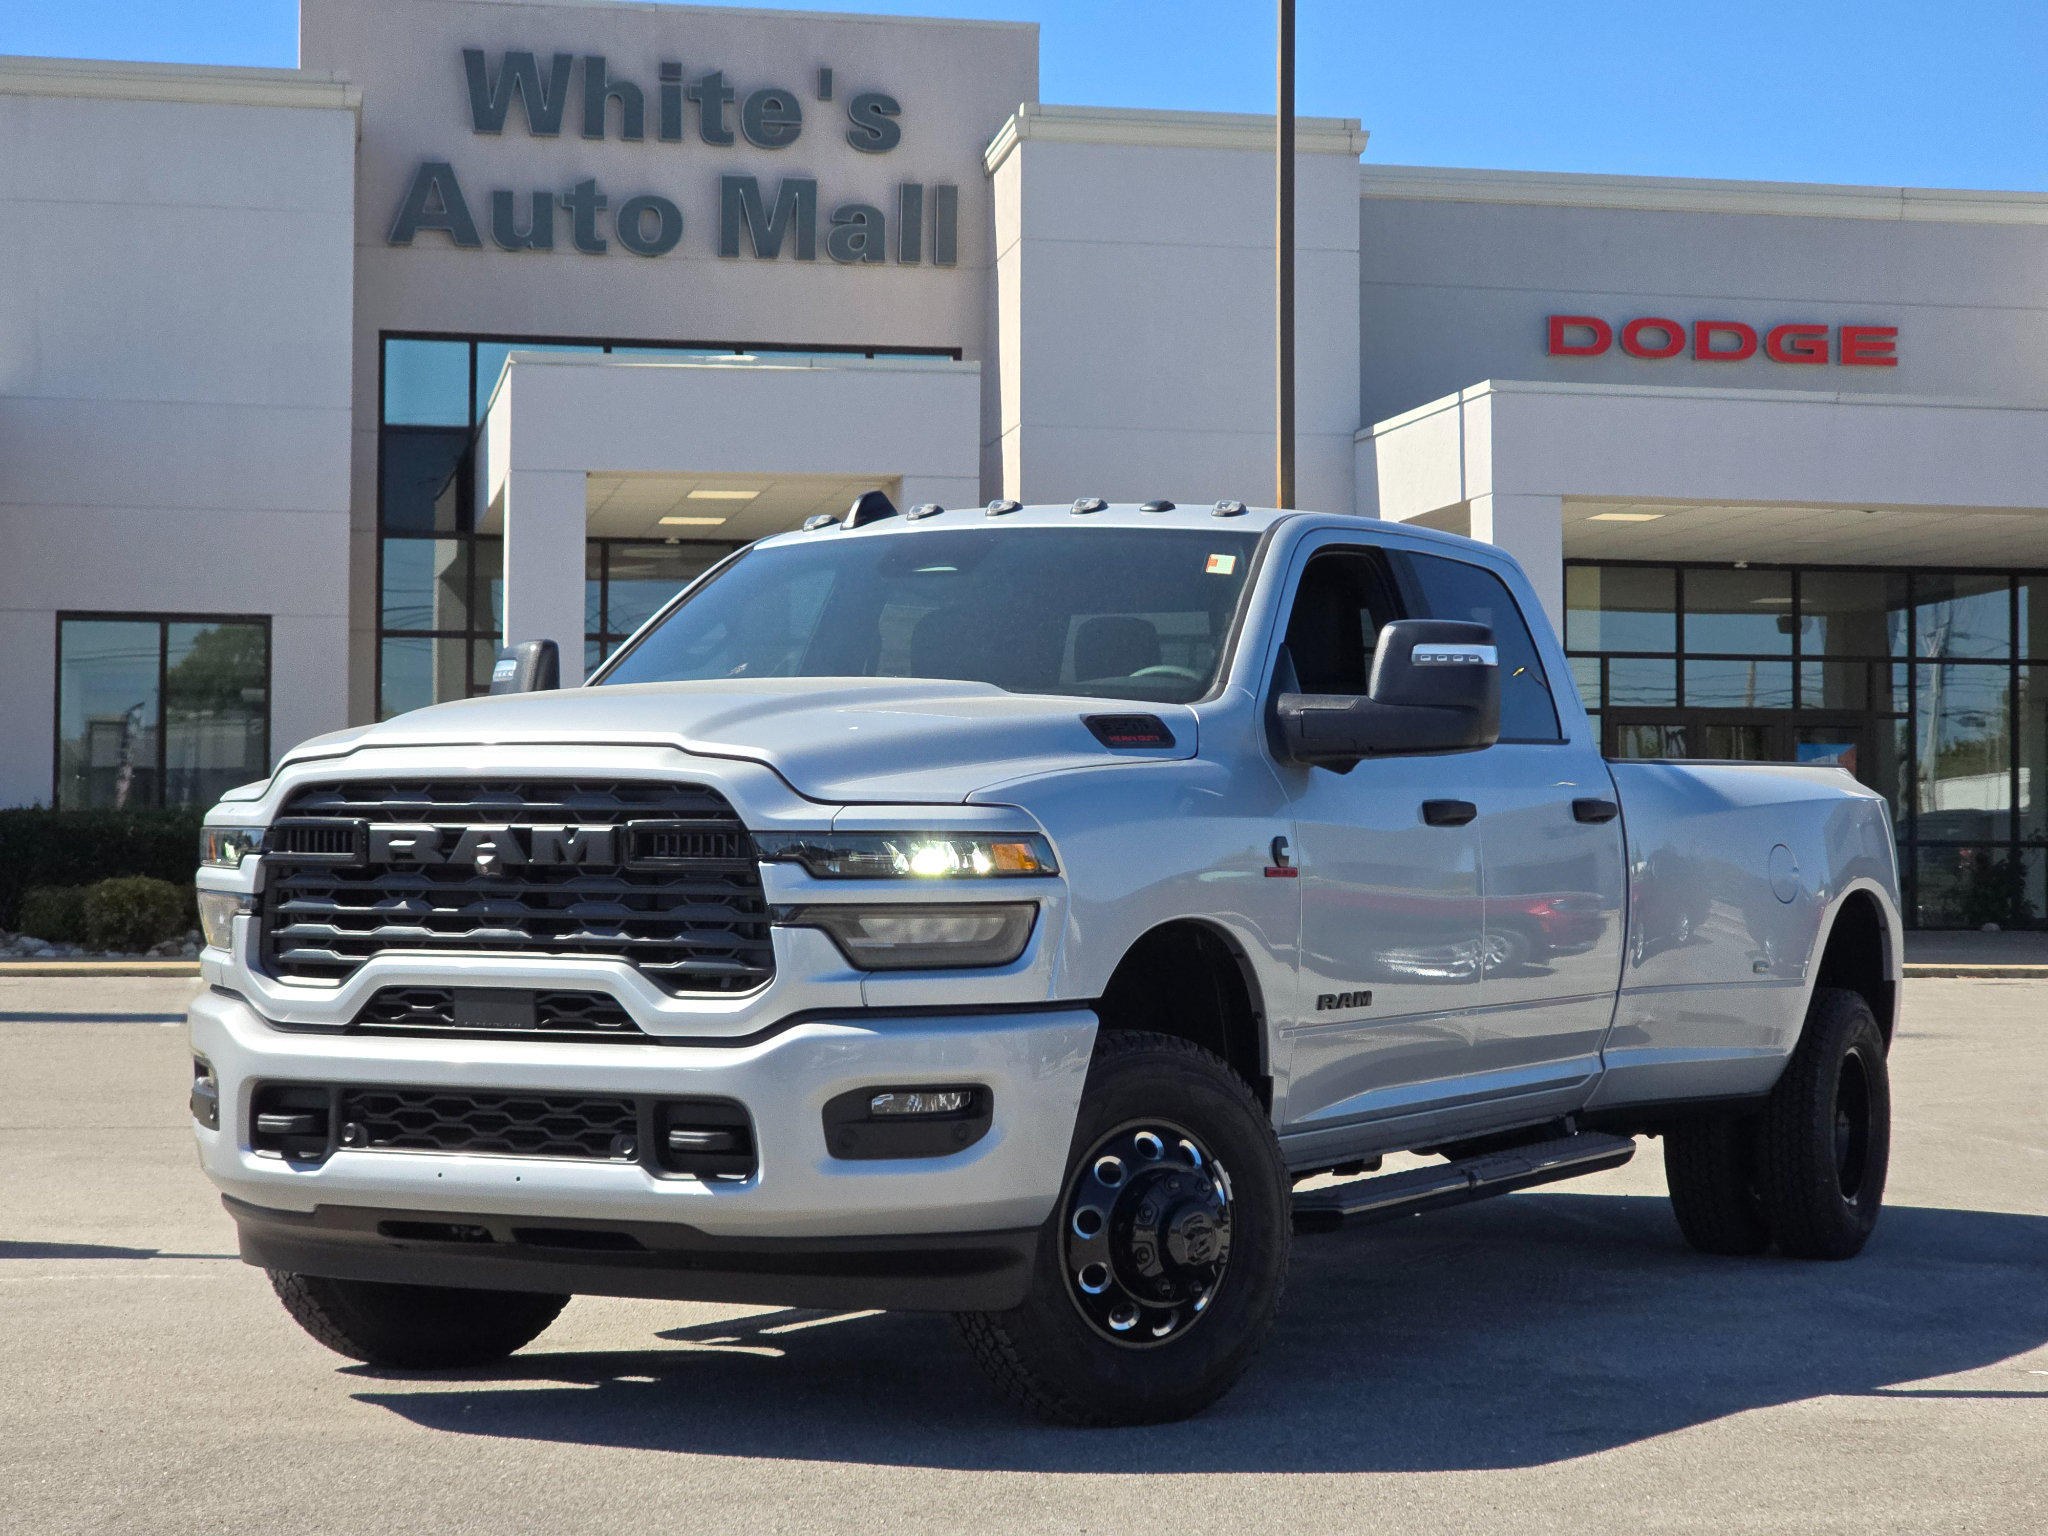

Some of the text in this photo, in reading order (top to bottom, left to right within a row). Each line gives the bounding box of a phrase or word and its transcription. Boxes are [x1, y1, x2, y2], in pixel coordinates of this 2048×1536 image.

[463, 49, 902, 153] White's
[387, 161, 959, 266] Auto Mall
[1546, 315, 1898, 366] DODGE
[369, 823, 618, 865] RAM
[1316, 990, 1373, 1011] RAM
